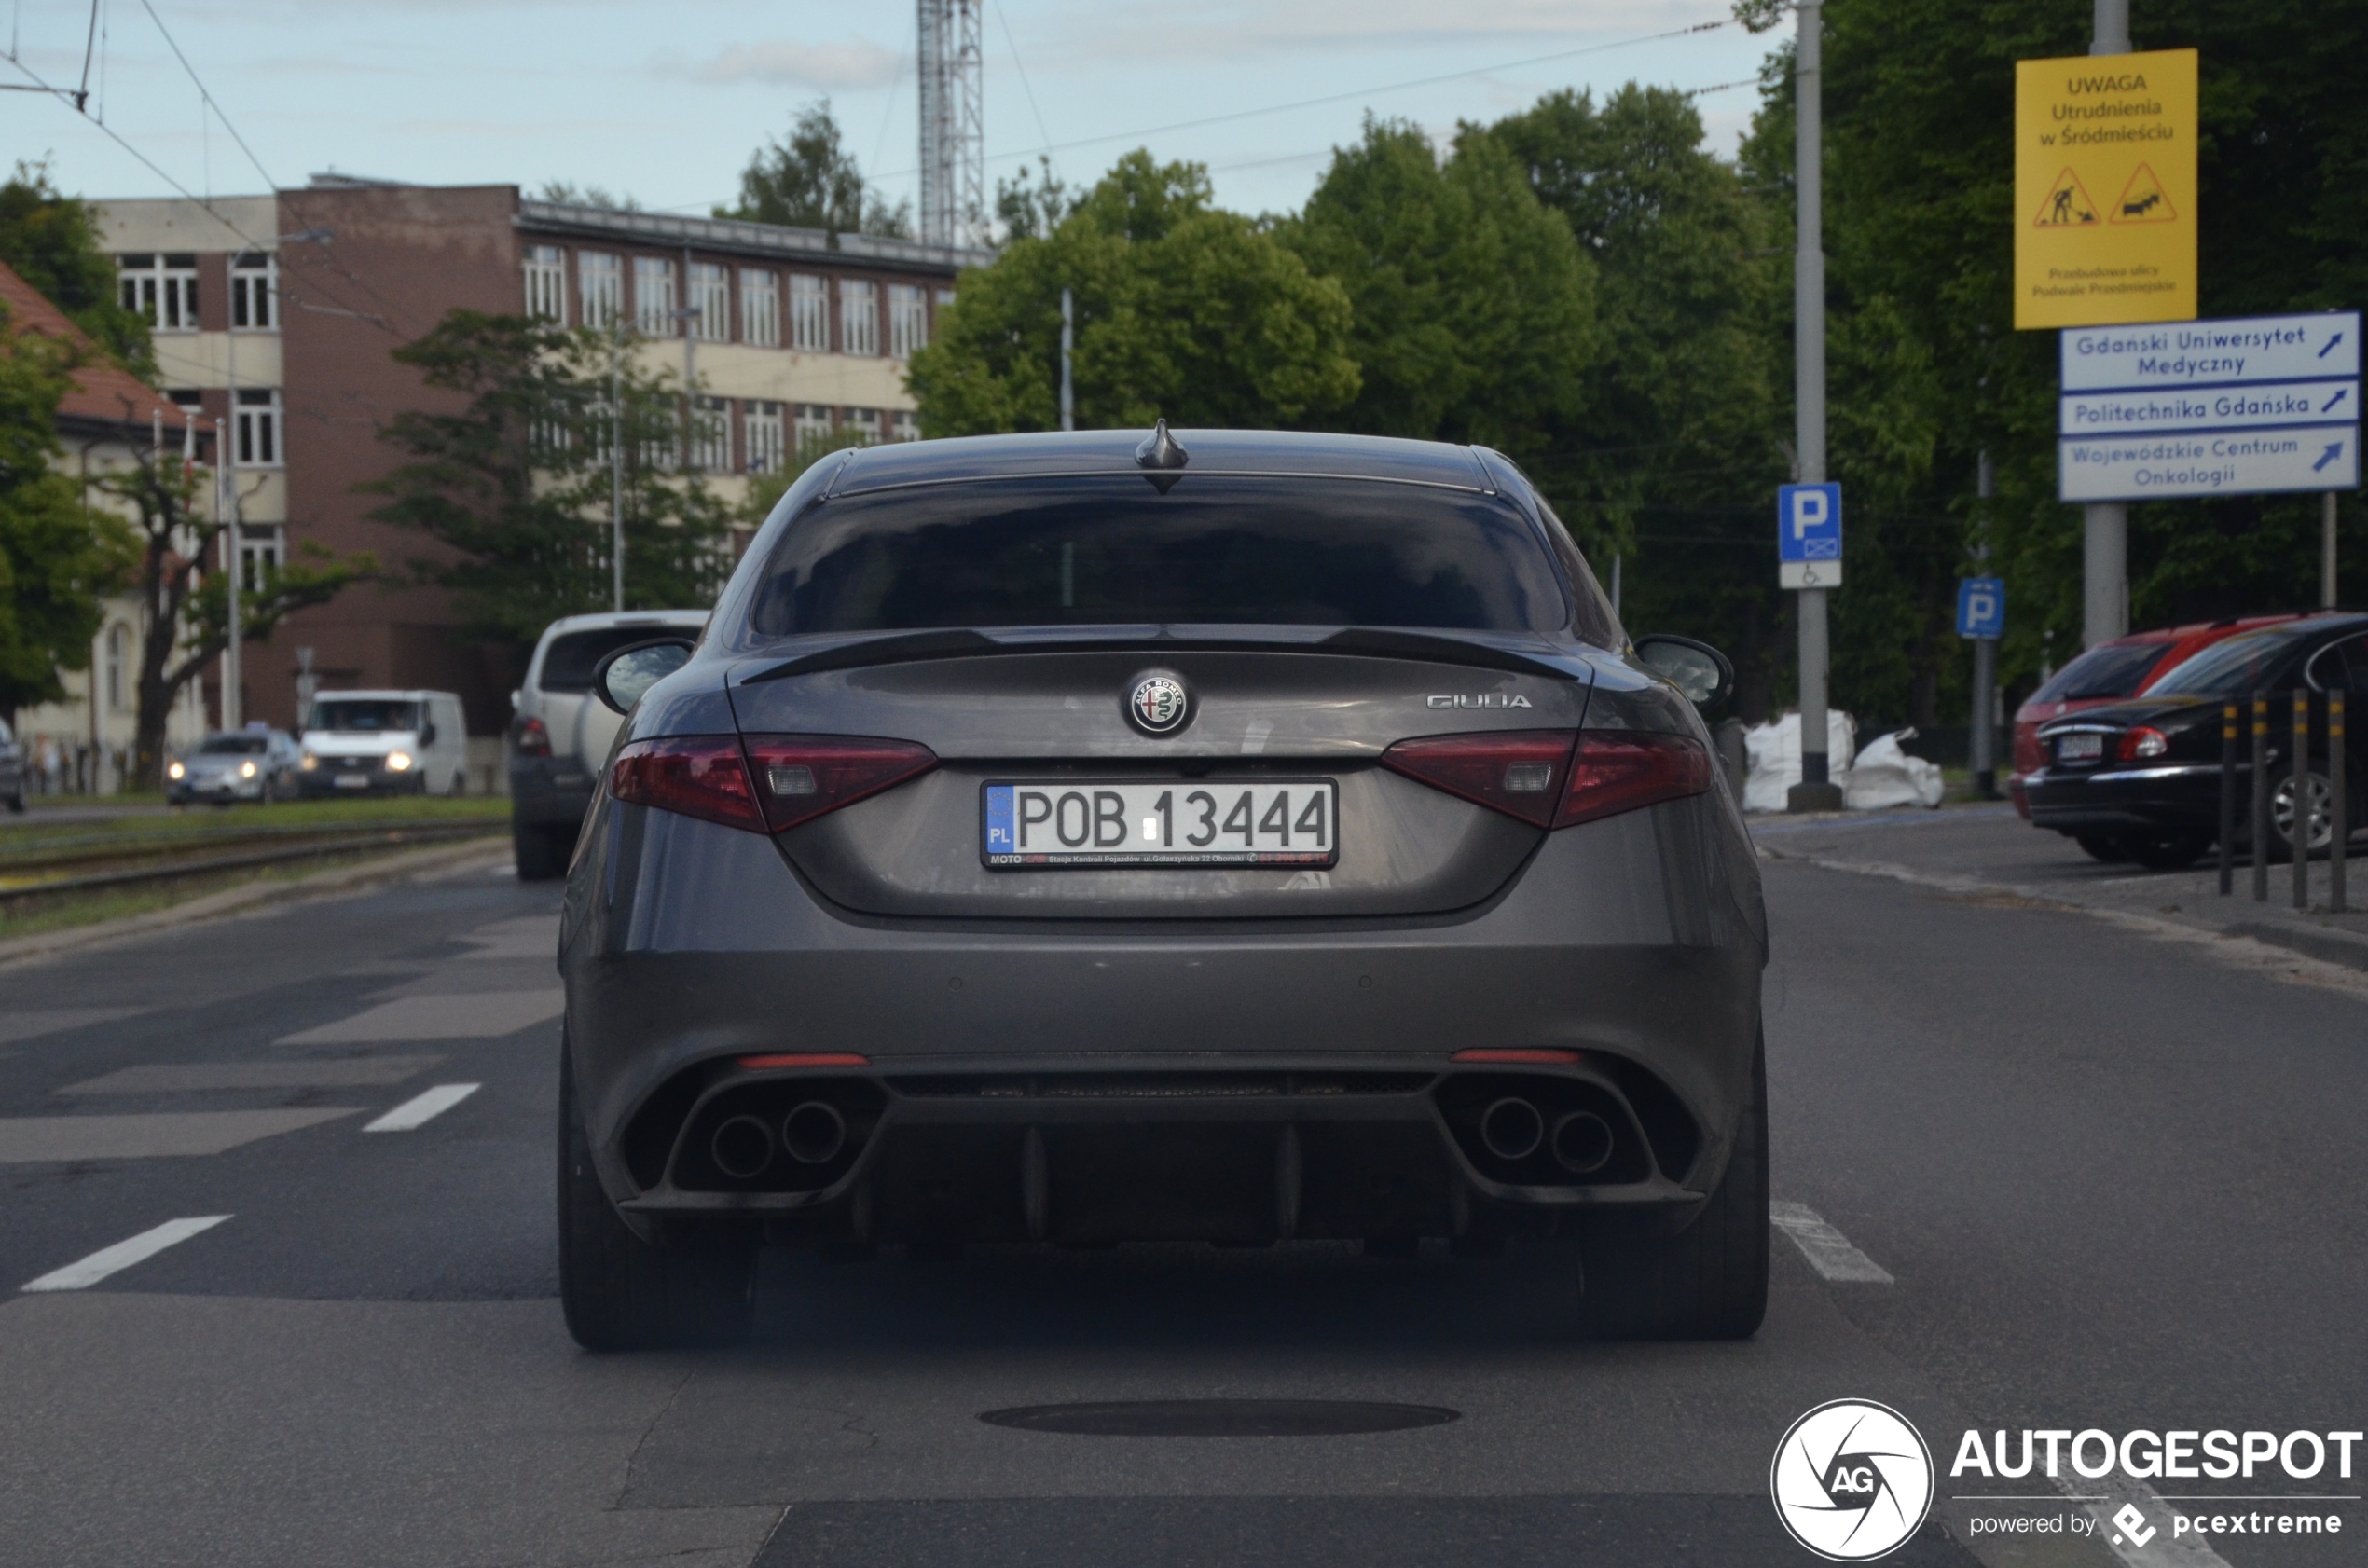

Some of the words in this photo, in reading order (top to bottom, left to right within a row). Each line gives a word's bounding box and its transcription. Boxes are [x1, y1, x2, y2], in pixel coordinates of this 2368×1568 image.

[2068, 74, 2147, 95] UWAGA
[2052, 99, 2162, 121] Utrudnienia
[2040, 133, 2056, 147] w
[2061, 122, 2174, 145] Śródmieściu
[2077, 331, 2168, 356] Gdański
[2178, 326, 2306, 351] Uniwersytet
[2139, 356, 2245, 378] Medyczny
[2075, 399, 2207, 422] Politechnika
[2215, 394, 2310, 417] Gdańska
[2072, 441, 2205, 466] Wojewódzkie
[2211, 437, 2299, 458] Centrum
[2135, 465, 2235, 487] Onkologii
[1792, 489, 1828, 540] P
[1967, 594, 1996, 629] P
[1136, 683, 1152, 705] ALFA
[1155, 681, 1182, 705] ROMEO
[1426, 695, 1533, 709] GIULIA
[1019, 791, 1128, 847] POB
[1154, 791, 1326, 847] 13444
[990, 828, 1011, 843] PL
[1049, 855, 1071, 863] Stacja
[1073, 855, 1103, 863] Kontroli
[1105, 855, 1140, 864] Pojazdów
[1201, 855, 1211, 863] 22
[1212, 854, 1245, 863] Oborniki
